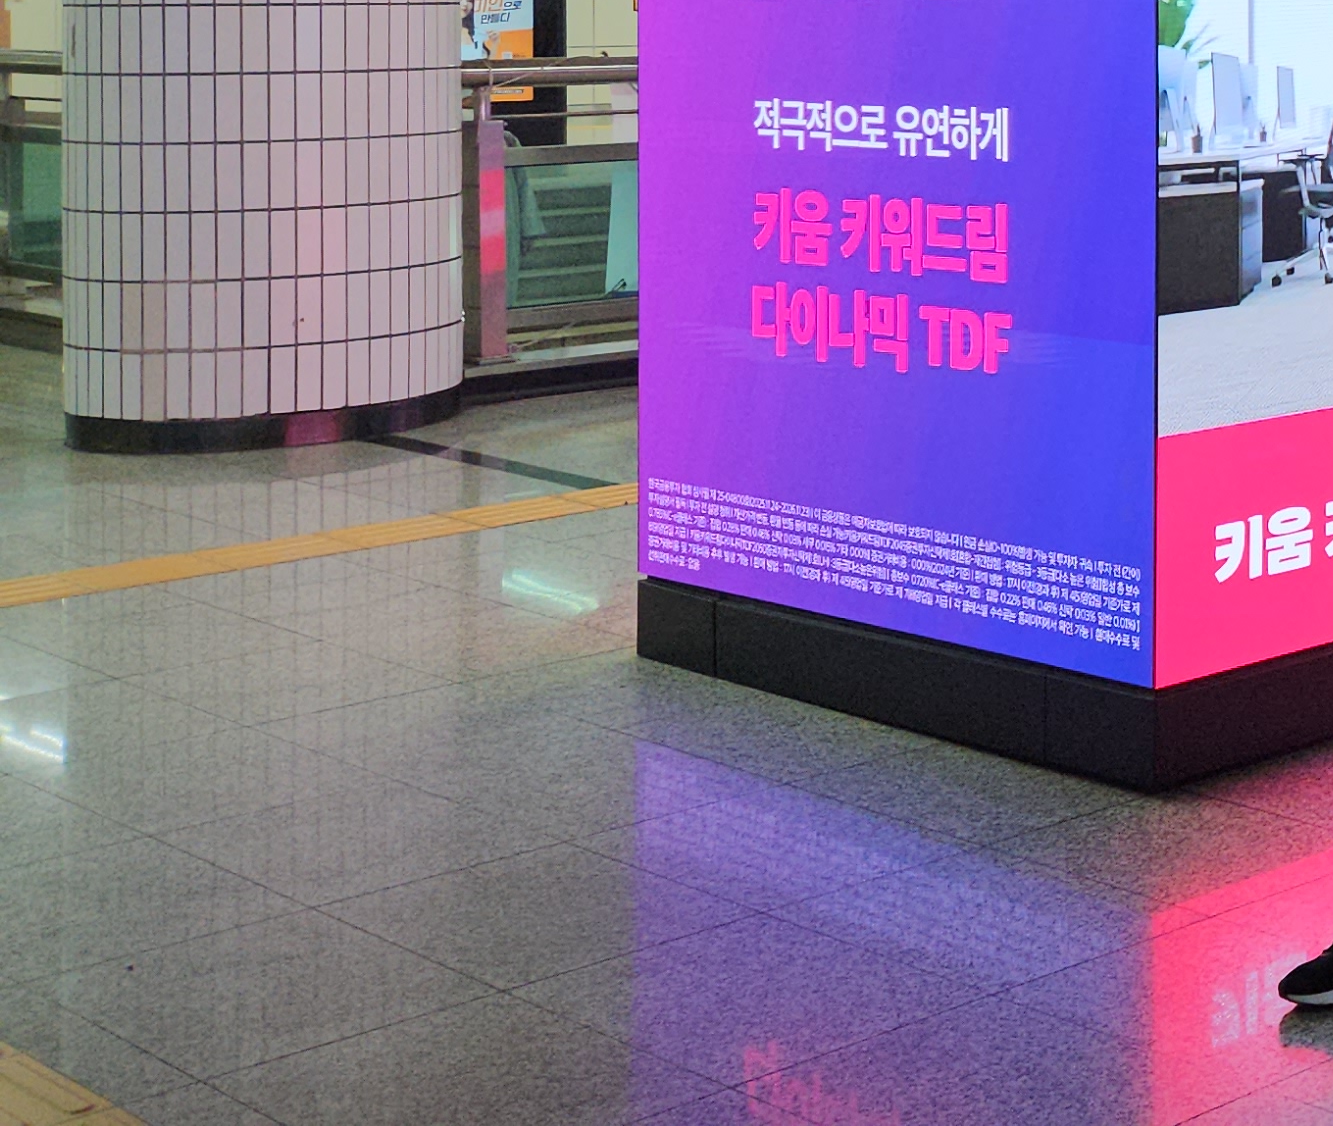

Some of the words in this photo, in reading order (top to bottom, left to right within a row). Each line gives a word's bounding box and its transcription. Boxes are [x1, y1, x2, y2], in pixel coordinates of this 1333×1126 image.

[754, 97, 888, 152] 적극적으로
[893, 103, 1010, 163] 유연하게
[752, 188, 833, 267] 키움
[840, 193, 1009, 284] 키워드림
[750, 281, 910, 374] 다이나믹
[918, 304, 1013, 376] TDF
[1214, 504, 1313, 583] 키움
